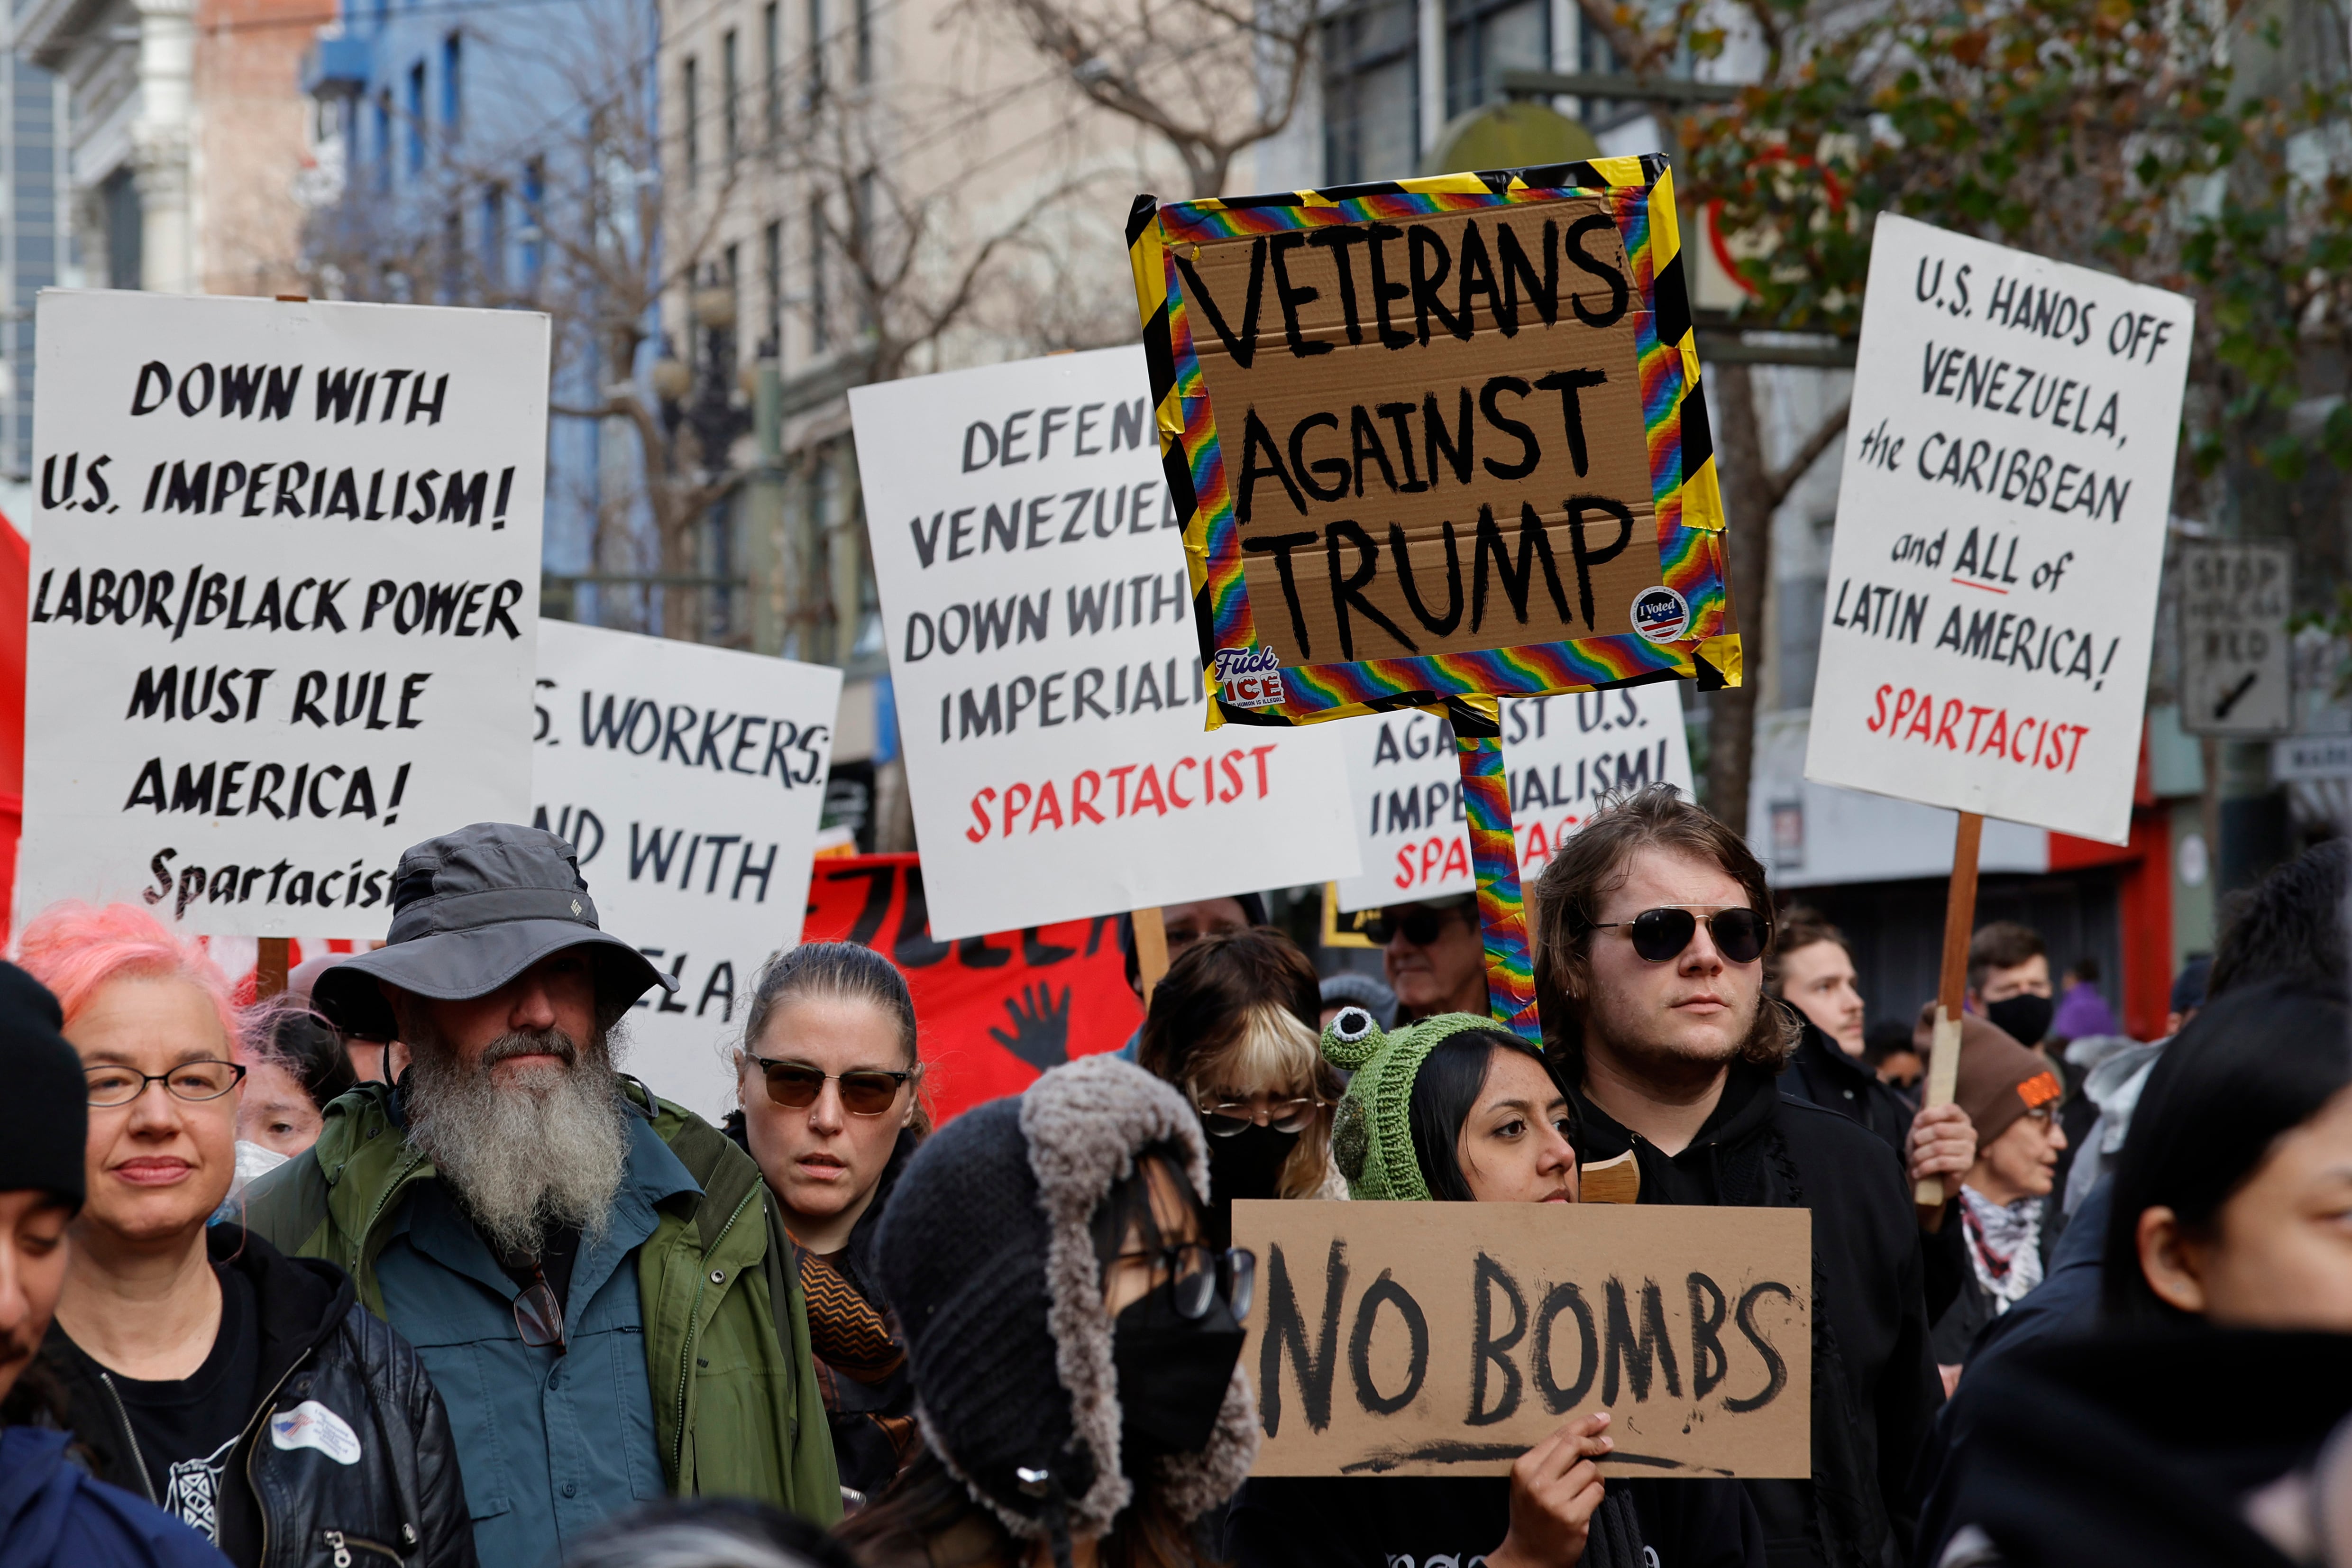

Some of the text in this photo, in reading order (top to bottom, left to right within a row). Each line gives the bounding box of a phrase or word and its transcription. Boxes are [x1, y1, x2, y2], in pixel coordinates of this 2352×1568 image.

[1173, 214, 1629, 368] VETERANS
[1917, 257, 2172, 363] U.S. HANDS OFF
[131, 361, 448, 425] DOWN WITH
[1922, 340, 2128, 449] VENEZUELA,
[1235, 367, 1608, 524] AGAINST
[1859, 419, 2131, 523] the CARIBBEAN
[42, 452, 515, 531] U.S. IMPERIALISM!
[910, 480, 1178, 569] VENEZUEL
[1243, 495, 1634, 661] TRUMP
[1892, 527, 2073, 591] and ALL of
[32, 564, 522, 642] LABOR/BLACK POWER
[905, 569, 1184, 662] DOWN WITH
[1639, 598, 1676, 616] I Voted
[1833, 579, 1928, 643] LATIN
[1936, 606, 2119, 691] AMERICA!
[126, 665, 432, 730] MUST RULE
[941, 654, 1204, 743] IMPERIALI
[1215, 647, 1277, 681] Fuck
[1223, 672, 1281, 701] ICE
[1578, 688, 1647, 733] U.S.
[1868, 685, 2088, 771] SPARTACIST
[123, 757, 411, 826] AMERICA!
[967, 745, 1275, 843] SPARTACIST
[143, 847, 397, 920] Spartacist
[630, 823, 778, 902] WITH
[1259, 1235, 1797, 1439] NO BOMBS
